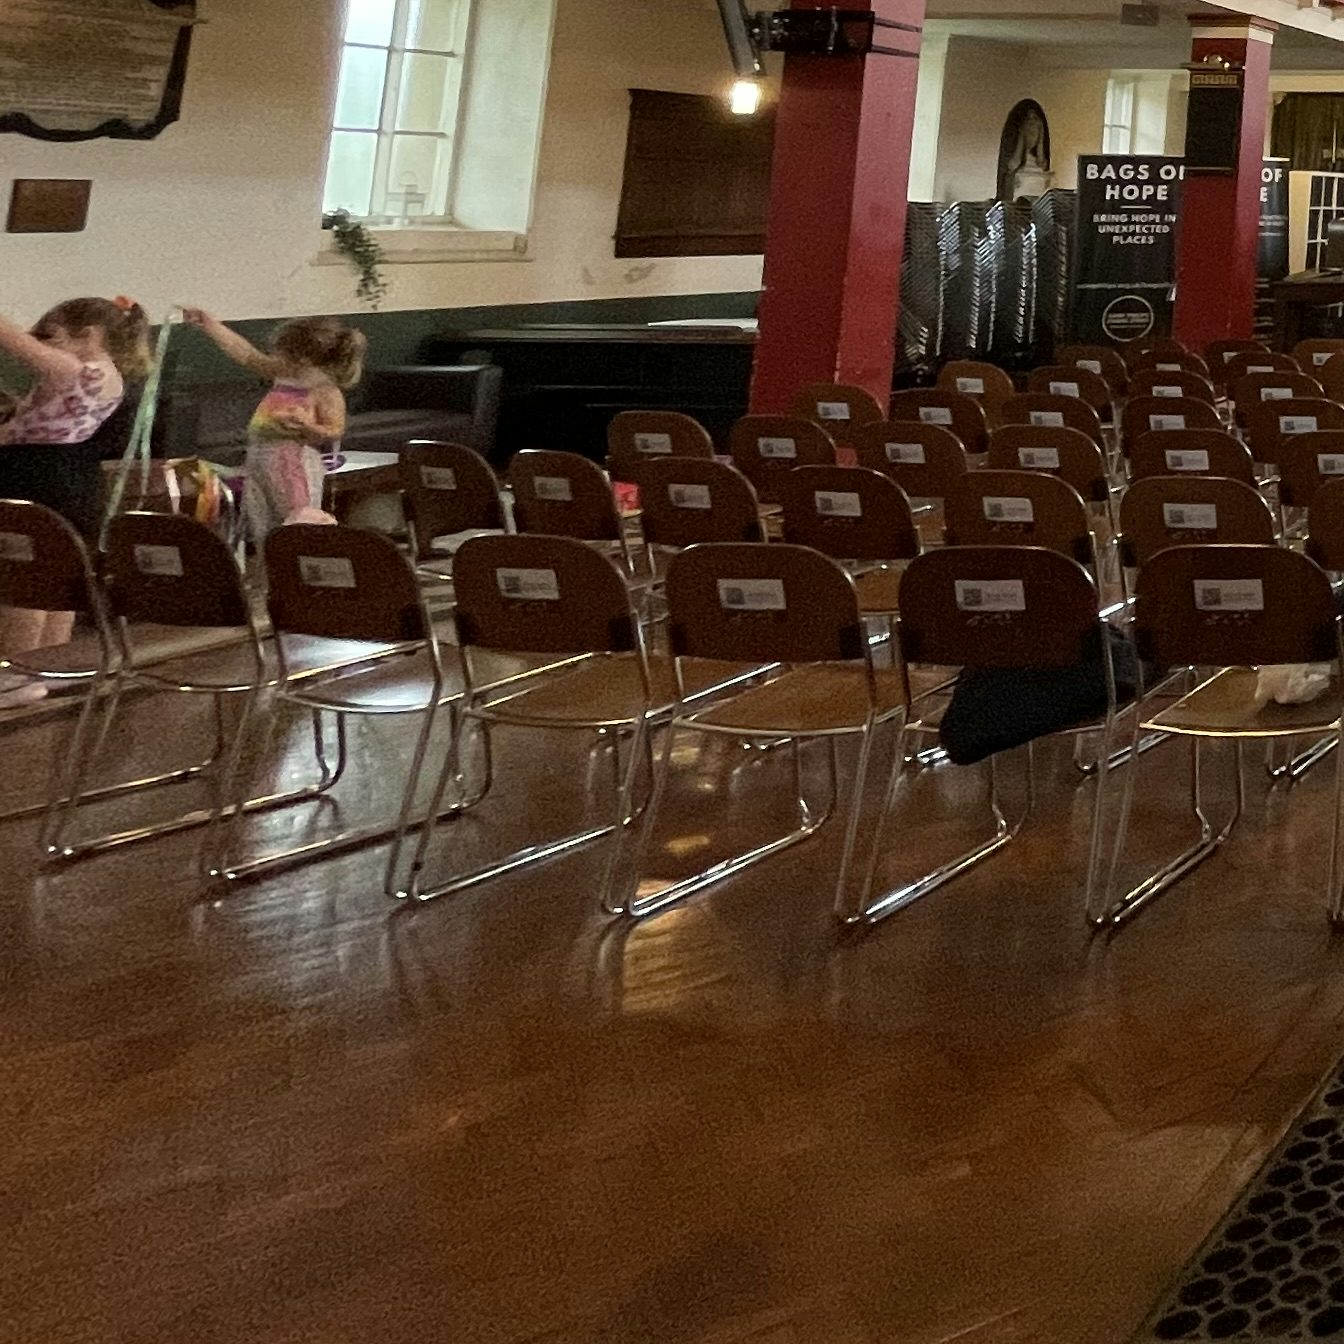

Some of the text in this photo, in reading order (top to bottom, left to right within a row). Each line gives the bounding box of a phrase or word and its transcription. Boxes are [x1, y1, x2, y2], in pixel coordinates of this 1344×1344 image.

[1086, 163, 1150, 180] BAGS
[1261, 167, 1282, 183] OF
[1105, 184, 1168, 201] HOPE
[1093, 213, 1176, 223] BRING HOPE IN
[1097, 224, 1170, 234] UNEXPECTED
[1112, 235, 1155, 245] PLACES
